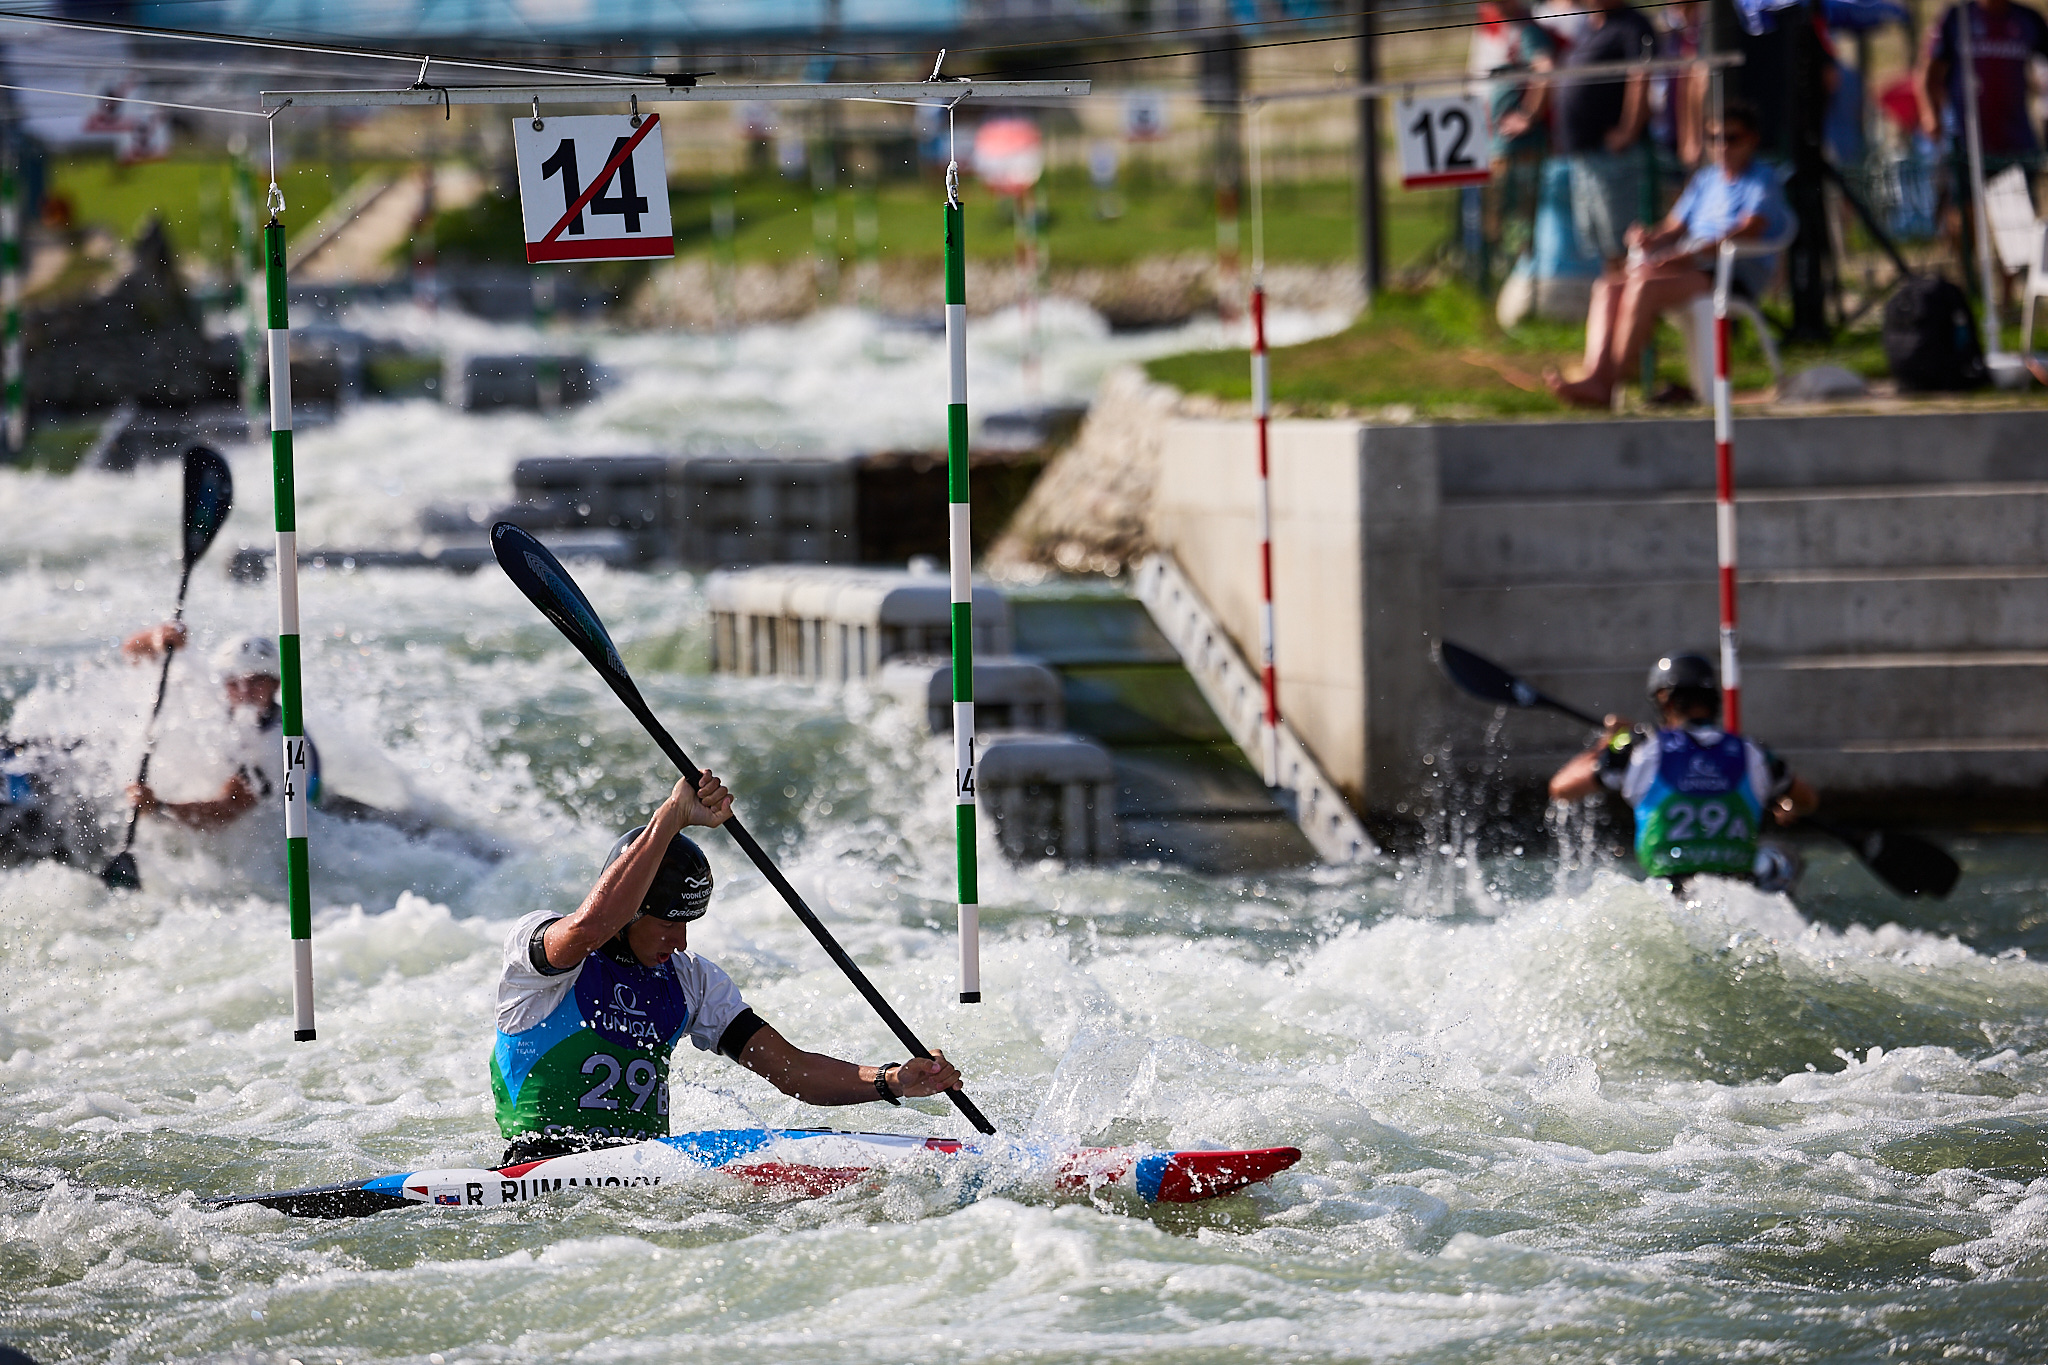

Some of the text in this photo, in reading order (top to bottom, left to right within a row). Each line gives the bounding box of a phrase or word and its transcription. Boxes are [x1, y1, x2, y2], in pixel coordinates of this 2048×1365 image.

[1409, 107, 1476, 173] 12
[542, 136, 649, 235] 14
[285, 740, 305, 770] 14
[956, 768, 975, 797] 14
[1666, 801, 1749, 842] 29A
[603, 1013, 659, 1038] UNIQA
